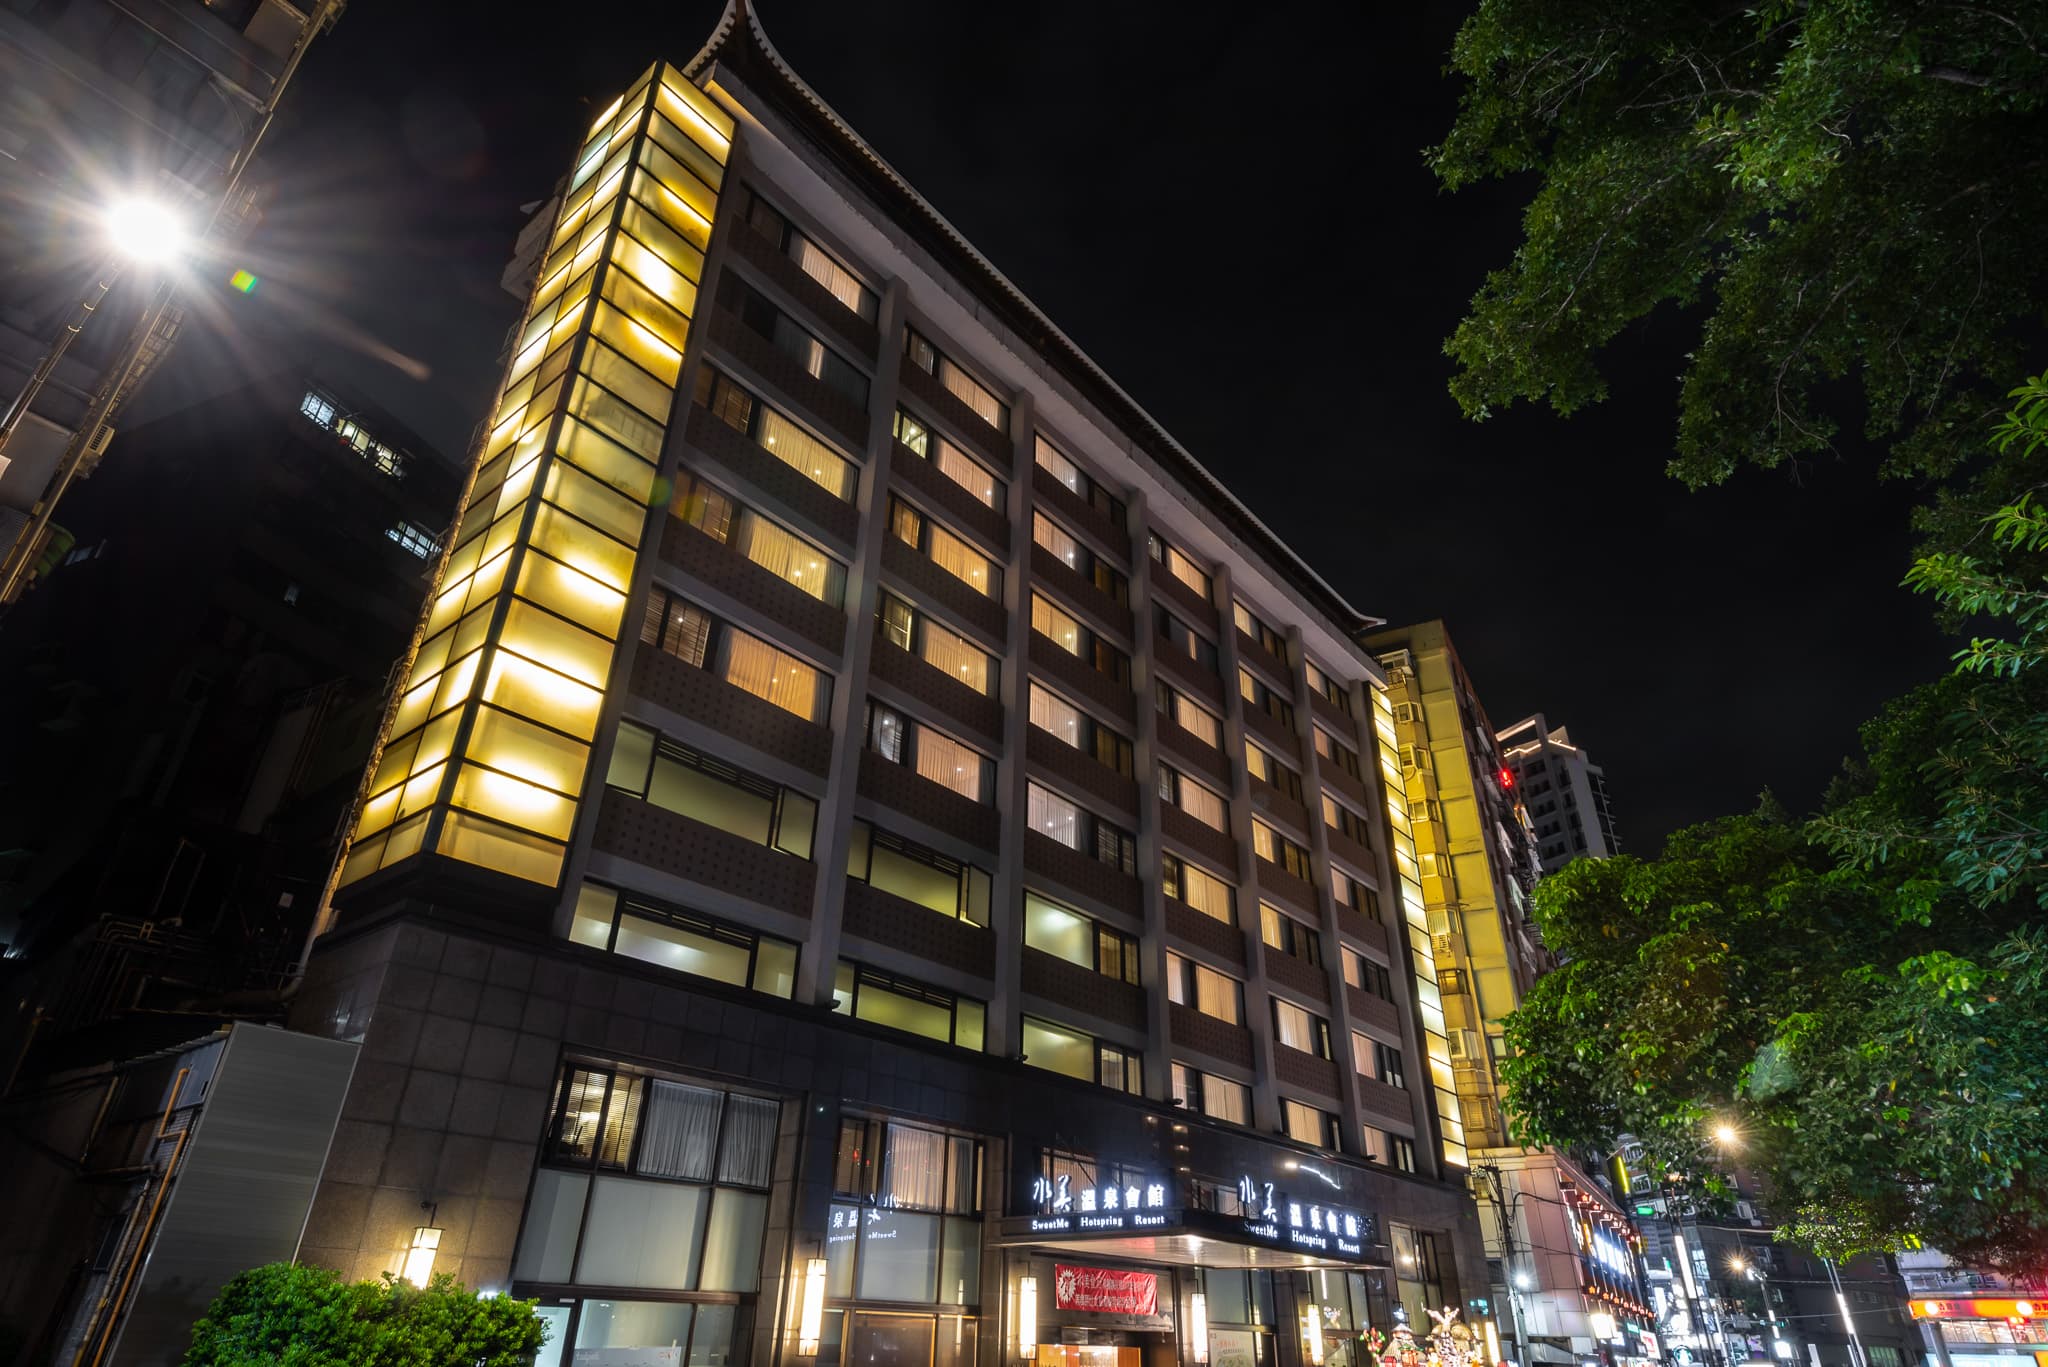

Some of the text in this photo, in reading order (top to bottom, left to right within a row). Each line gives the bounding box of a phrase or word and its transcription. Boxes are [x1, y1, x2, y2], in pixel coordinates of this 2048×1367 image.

[1032, 1214, 1165, 1230] SweetMe Hotspring Resort
[1244, 1221, 1361, 1254] SweetMe Hotspring Resort
